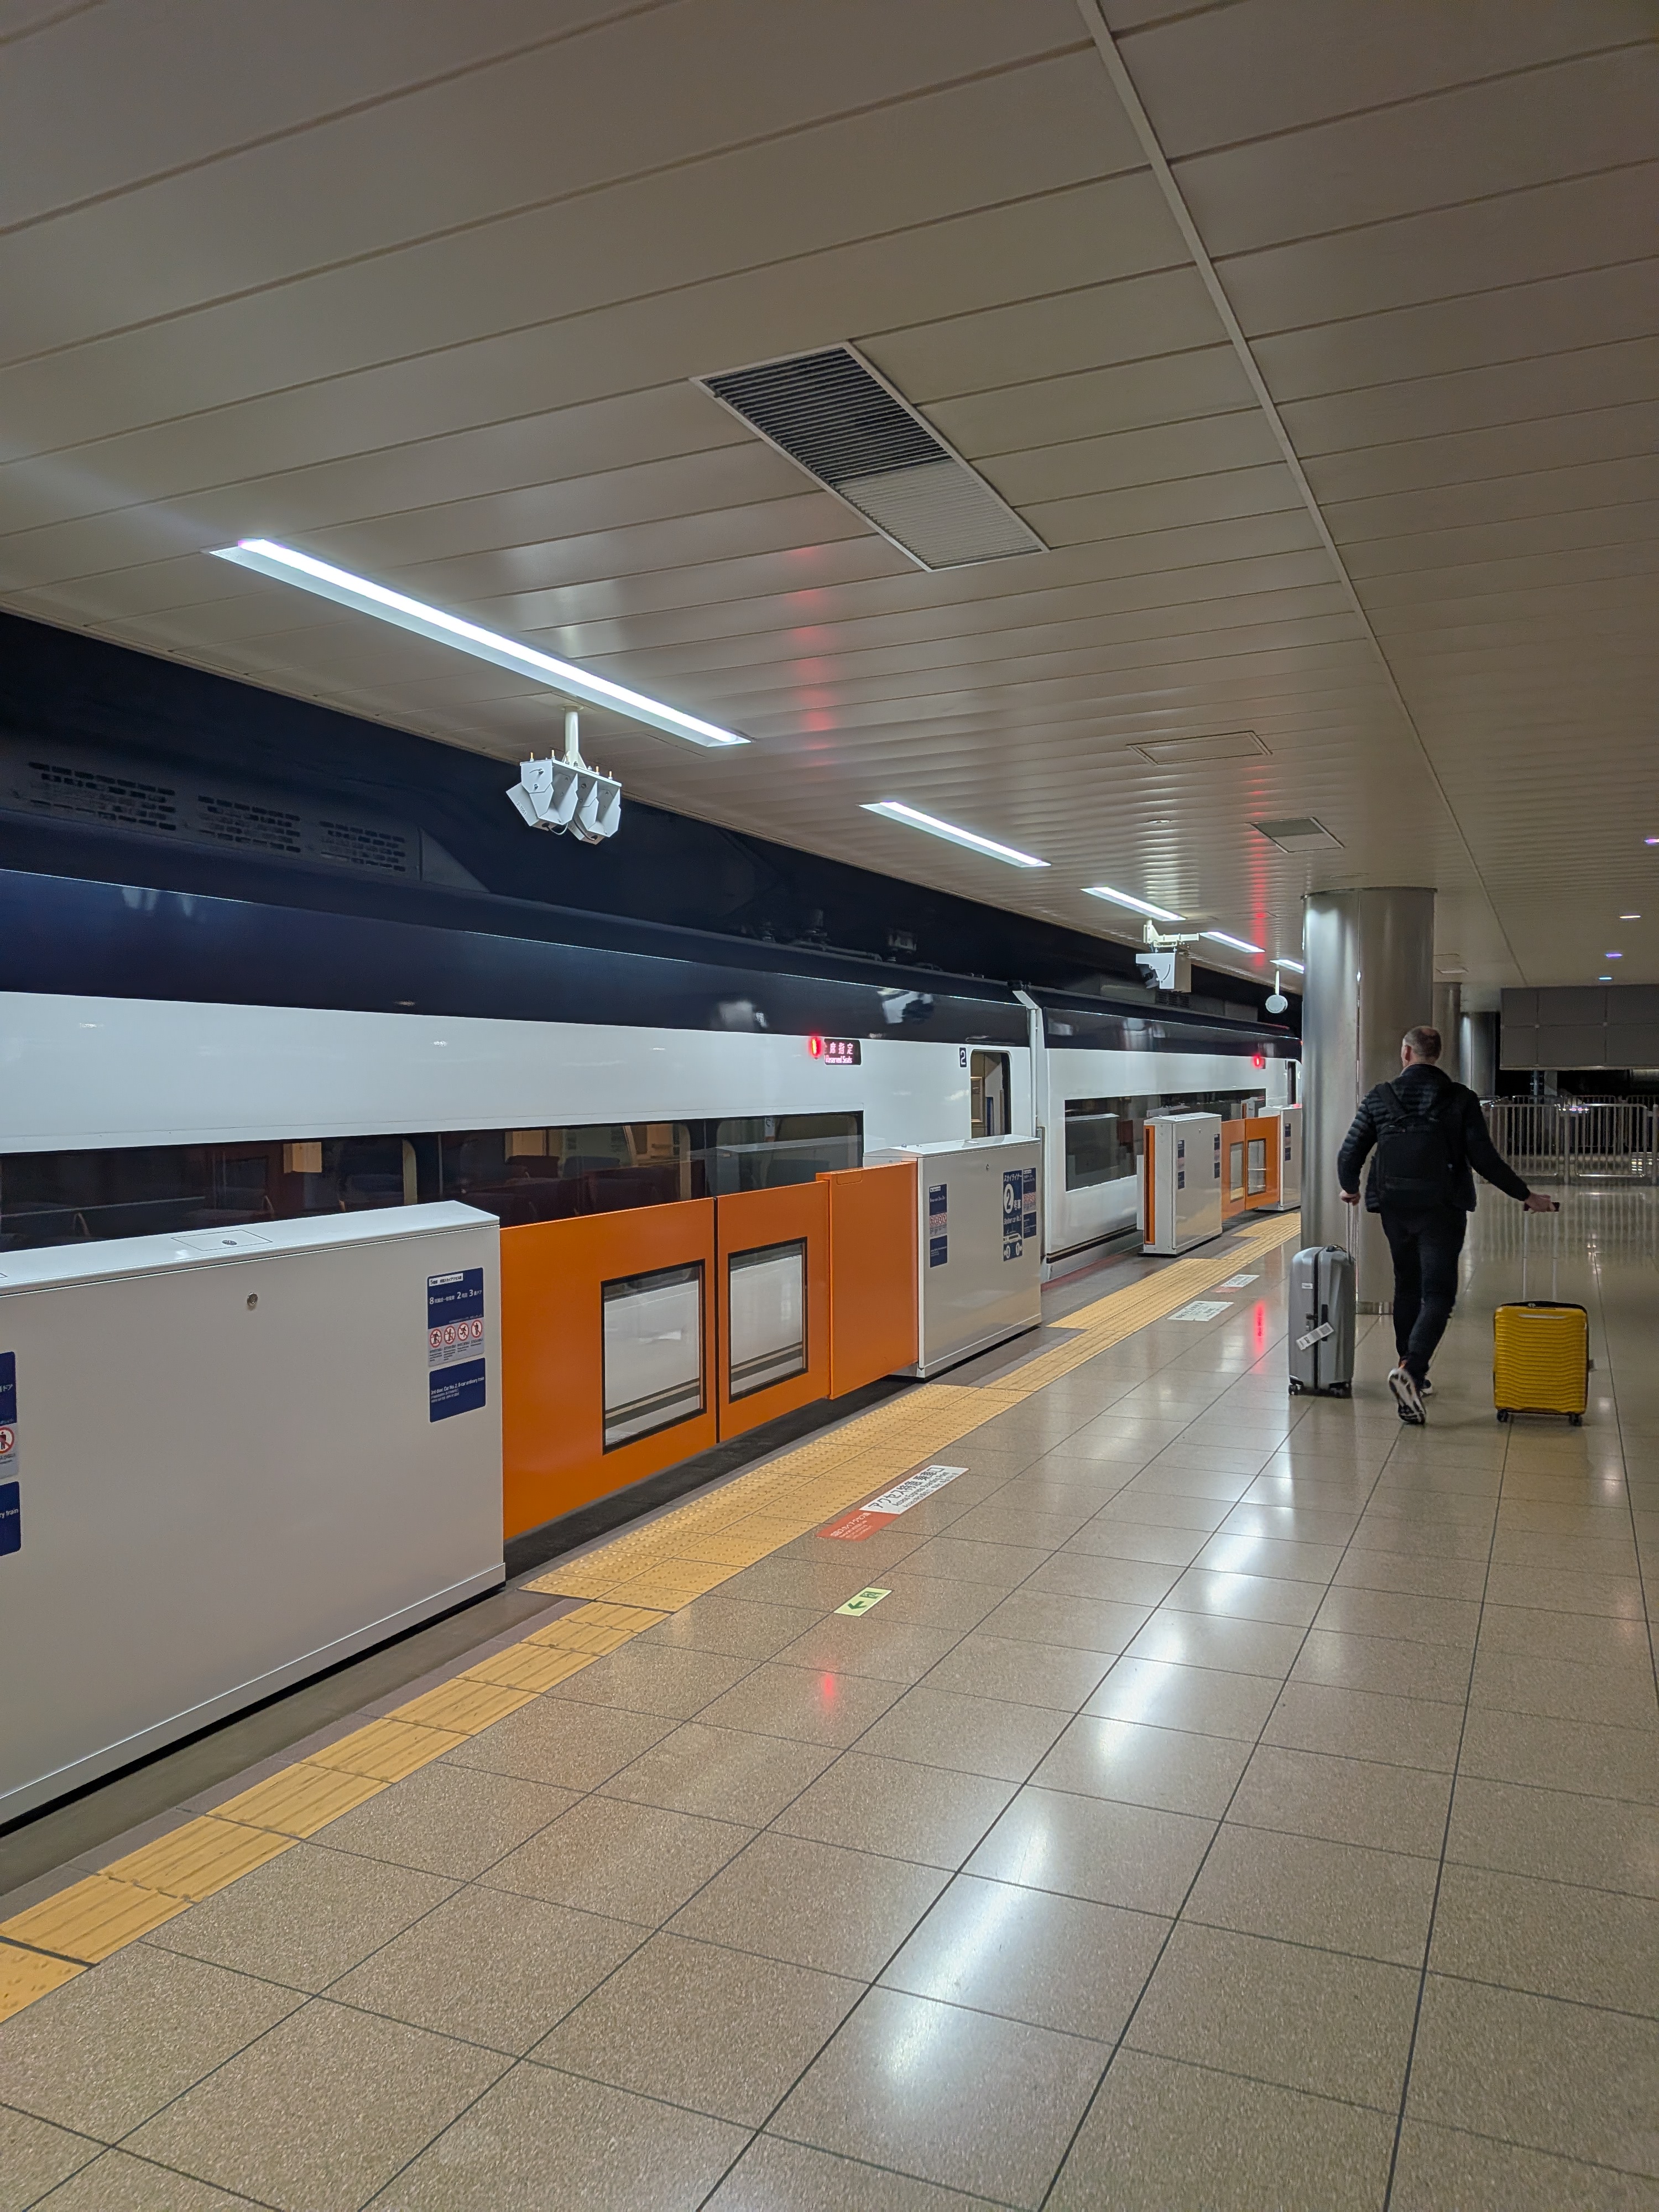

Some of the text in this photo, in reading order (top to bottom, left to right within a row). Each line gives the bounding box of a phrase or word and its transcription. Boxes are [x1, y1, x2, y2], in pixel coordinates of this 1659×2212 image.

[826, 1055, 842, 1063] Reserved
[960, 1050, 966, 1065] 2
[1006, 1188, 1011, 1209] 2
